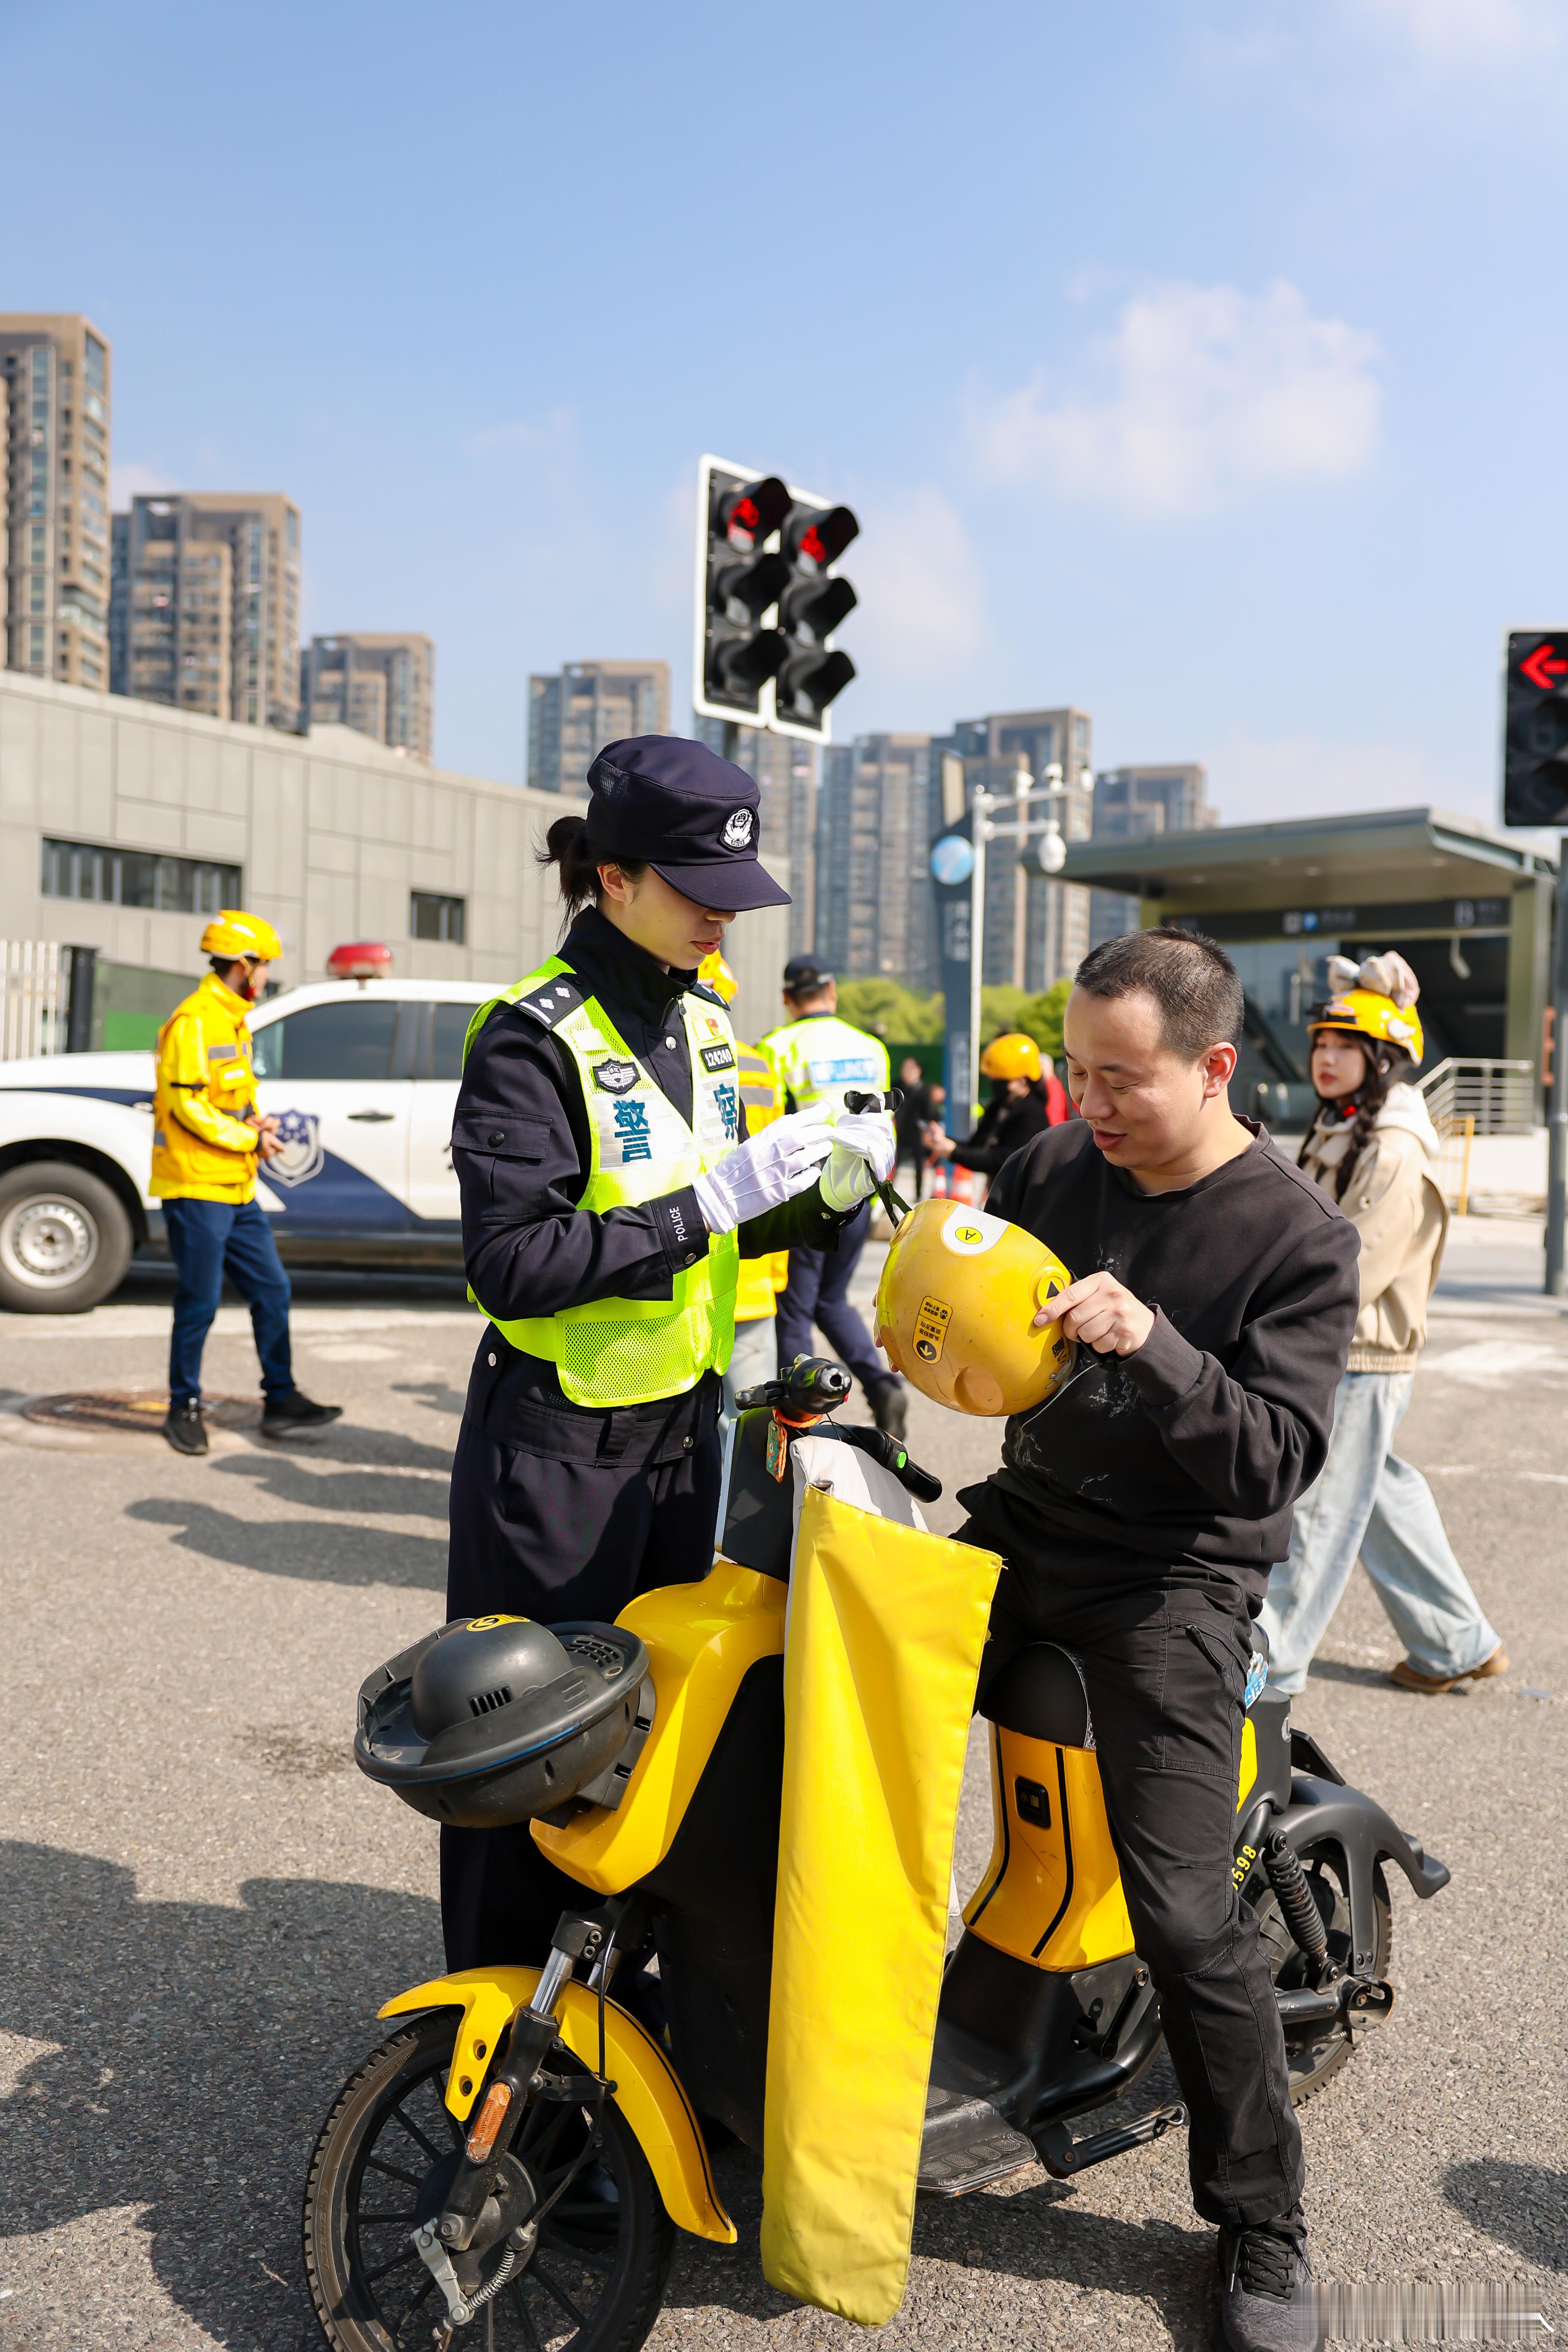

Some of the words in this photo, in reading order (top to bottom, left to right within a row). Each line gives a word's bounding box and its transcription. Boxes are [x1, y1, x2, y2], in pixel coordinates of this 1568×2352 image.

[705, 1048, 732, 1067] 124240
[613, 1099, 652, 1162] 警
[713, 1083, 738, 1140] 察
[669, 1206, 688, 1242] POLICE
[965, 1230, 977, 1240] A
[319, 2190, 329, 2269] AIRLESS
